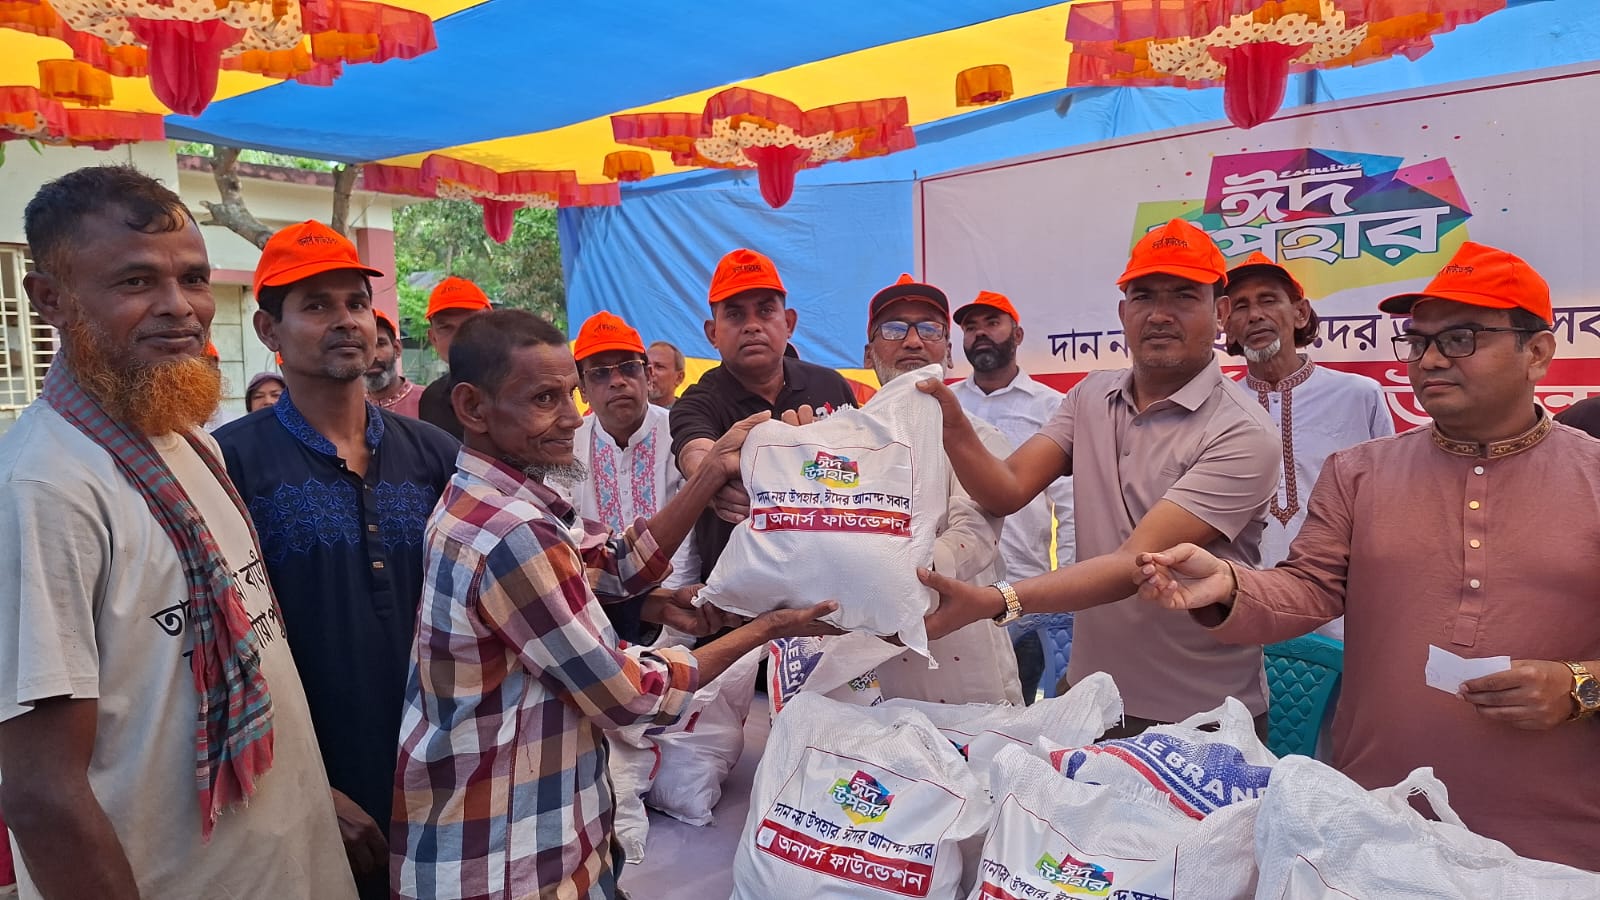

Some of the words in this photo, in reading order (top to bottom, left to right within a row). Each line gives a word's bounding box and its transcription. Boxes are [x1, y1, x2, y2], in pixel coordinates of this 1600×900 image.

[1221, 163, 1362, 227] ঈদ
[1148, 206, 1450, 264] পহার
[1047, 329, 1102, 362] দান
[1313, 315, 1382, 351] দের
[805, 466, 857, 484] উপহার
[817, 456, 842, 469] ঈদ
[772, 491, 787, 503] নয়
[825, 488, 850, 506] ঈদের
[852, 492, 885, 506] আনন্দ
[887, 494, 910, 511] সবার
[769, 509, 817, 527] অনার্স
[822, 511, 906, 532] ফাউন্ডেশন
[832, 786, 889, 817] উপহার
[850, 777, 882, 803] ঈদ
[774, 802, 793, 818] দান
[906, 843, 935, 859] সবার
[778, 834, 831, 865] অনার্স
[829, 852, 927, 891] ফাউন্ডেশন
[1039, 861, 1109, 891] উপহার
[1061, 861, 1096, 877] ঈদ
